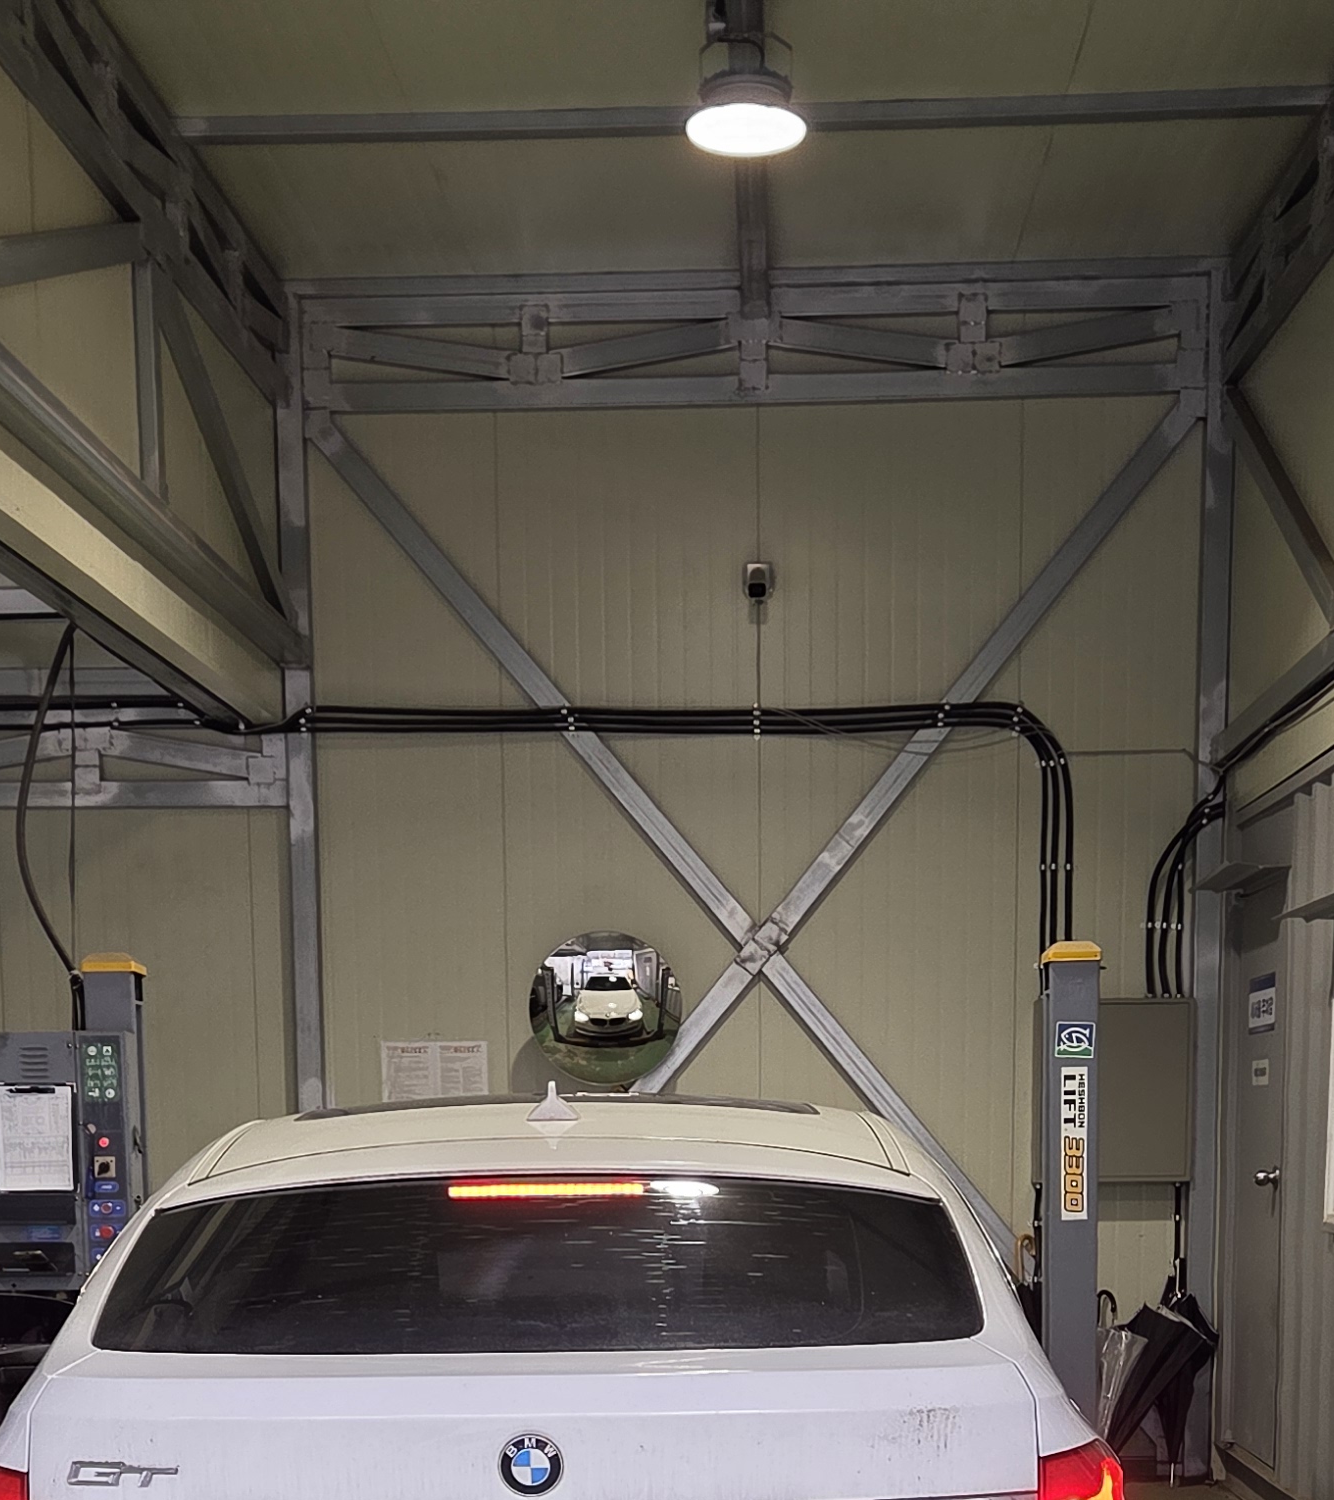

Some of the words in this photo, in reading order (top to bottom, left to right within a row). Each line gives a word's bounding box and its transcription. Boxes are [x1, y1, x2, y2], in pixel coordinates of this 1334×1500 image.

[1063, 1074, 1077, 1128] LIFT
[1077, 1073, 1086, 1128] HESHBON
[1063, 1136, 1085, 1212] 3300
[67, 1460, 179, 1488] GT
[505, 1436, 558, 1458] BMW
